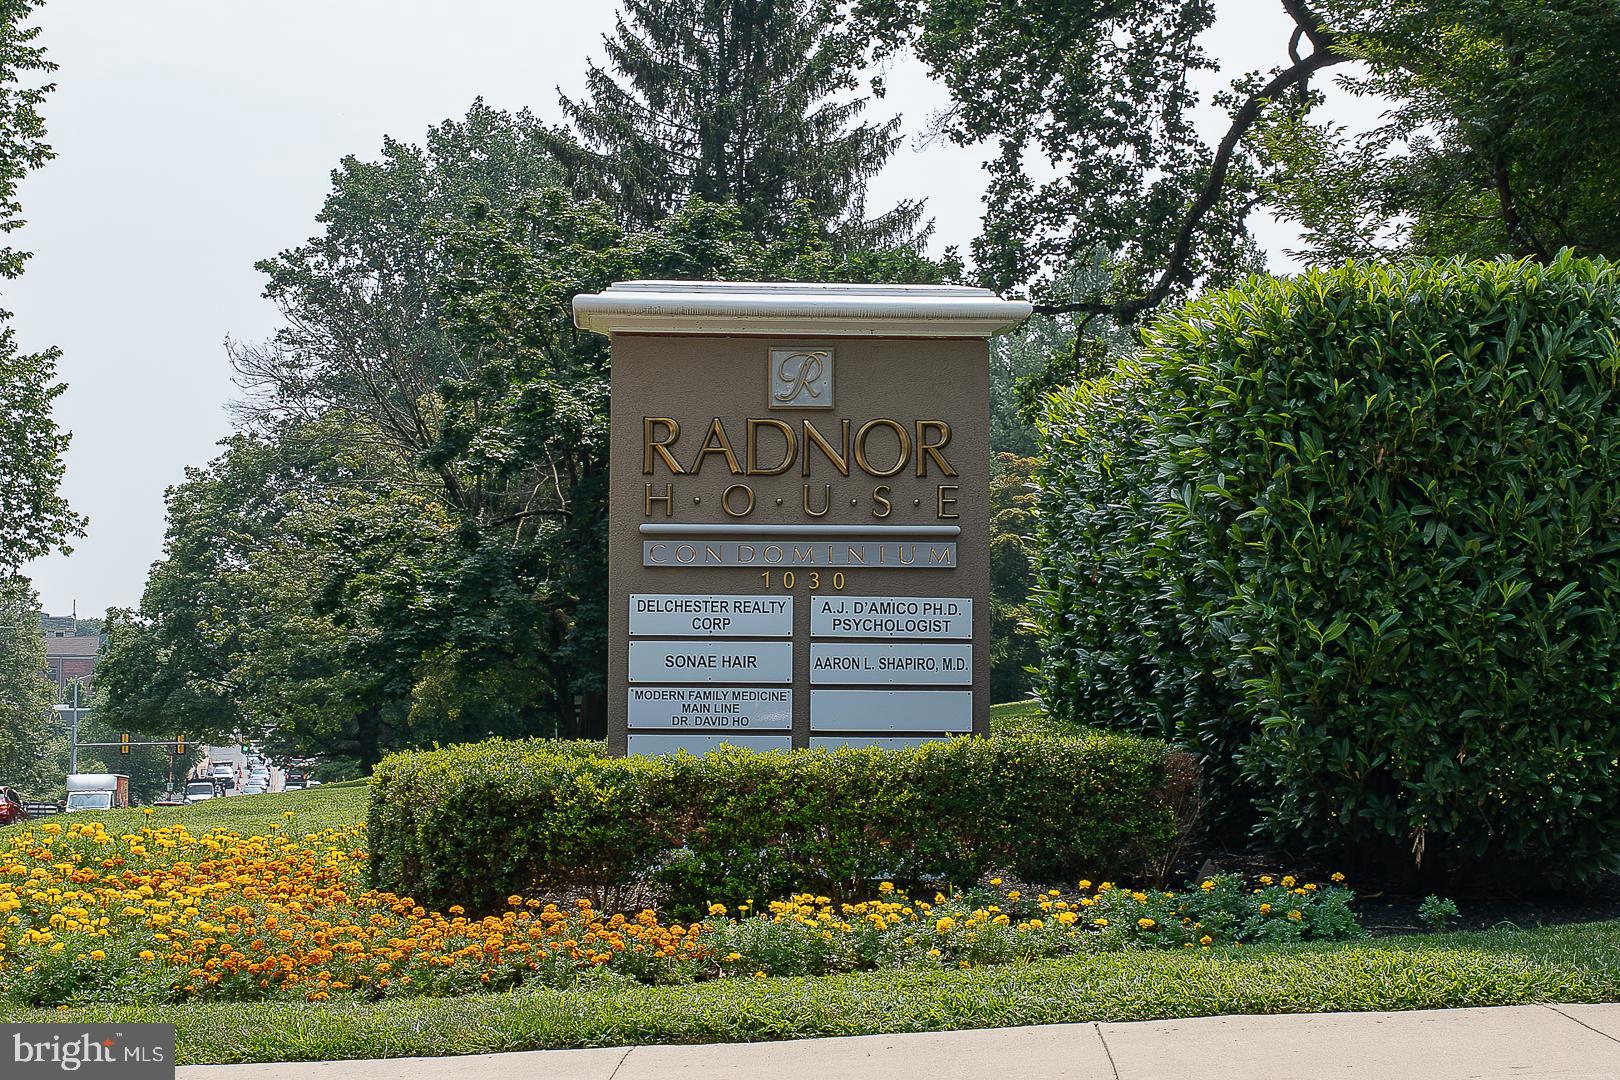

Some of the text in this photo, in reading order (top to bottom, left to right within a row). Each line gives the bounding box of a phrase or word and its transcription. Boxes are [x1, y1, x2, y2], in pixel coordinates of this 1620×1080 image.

[642, 416, 959, 477] RADNOR
[649, 544, 951, 564] CONDOMINIUM
[761, 571, 846, 590] 1030
[636, 599, 787, 614] DELCHESTER REALTY
[821, 601, 962, 617] A.J. D'AMICO PH.D.
[691, 617, 731, 631] CORP
[832, 618, 951, 633] PSYCHOLOGIST
[665, 655, 757, 669] SONAE HAIR
[814, 657, 969, 672] AARON L. SHAPIRO, M.D.
[634, 690, 787, 702] MODERN FAMILY MEDICINE
[682, 704, 740, 714] MAIN LINE
[671, 716, 750, 727] DR. DAVID HO
